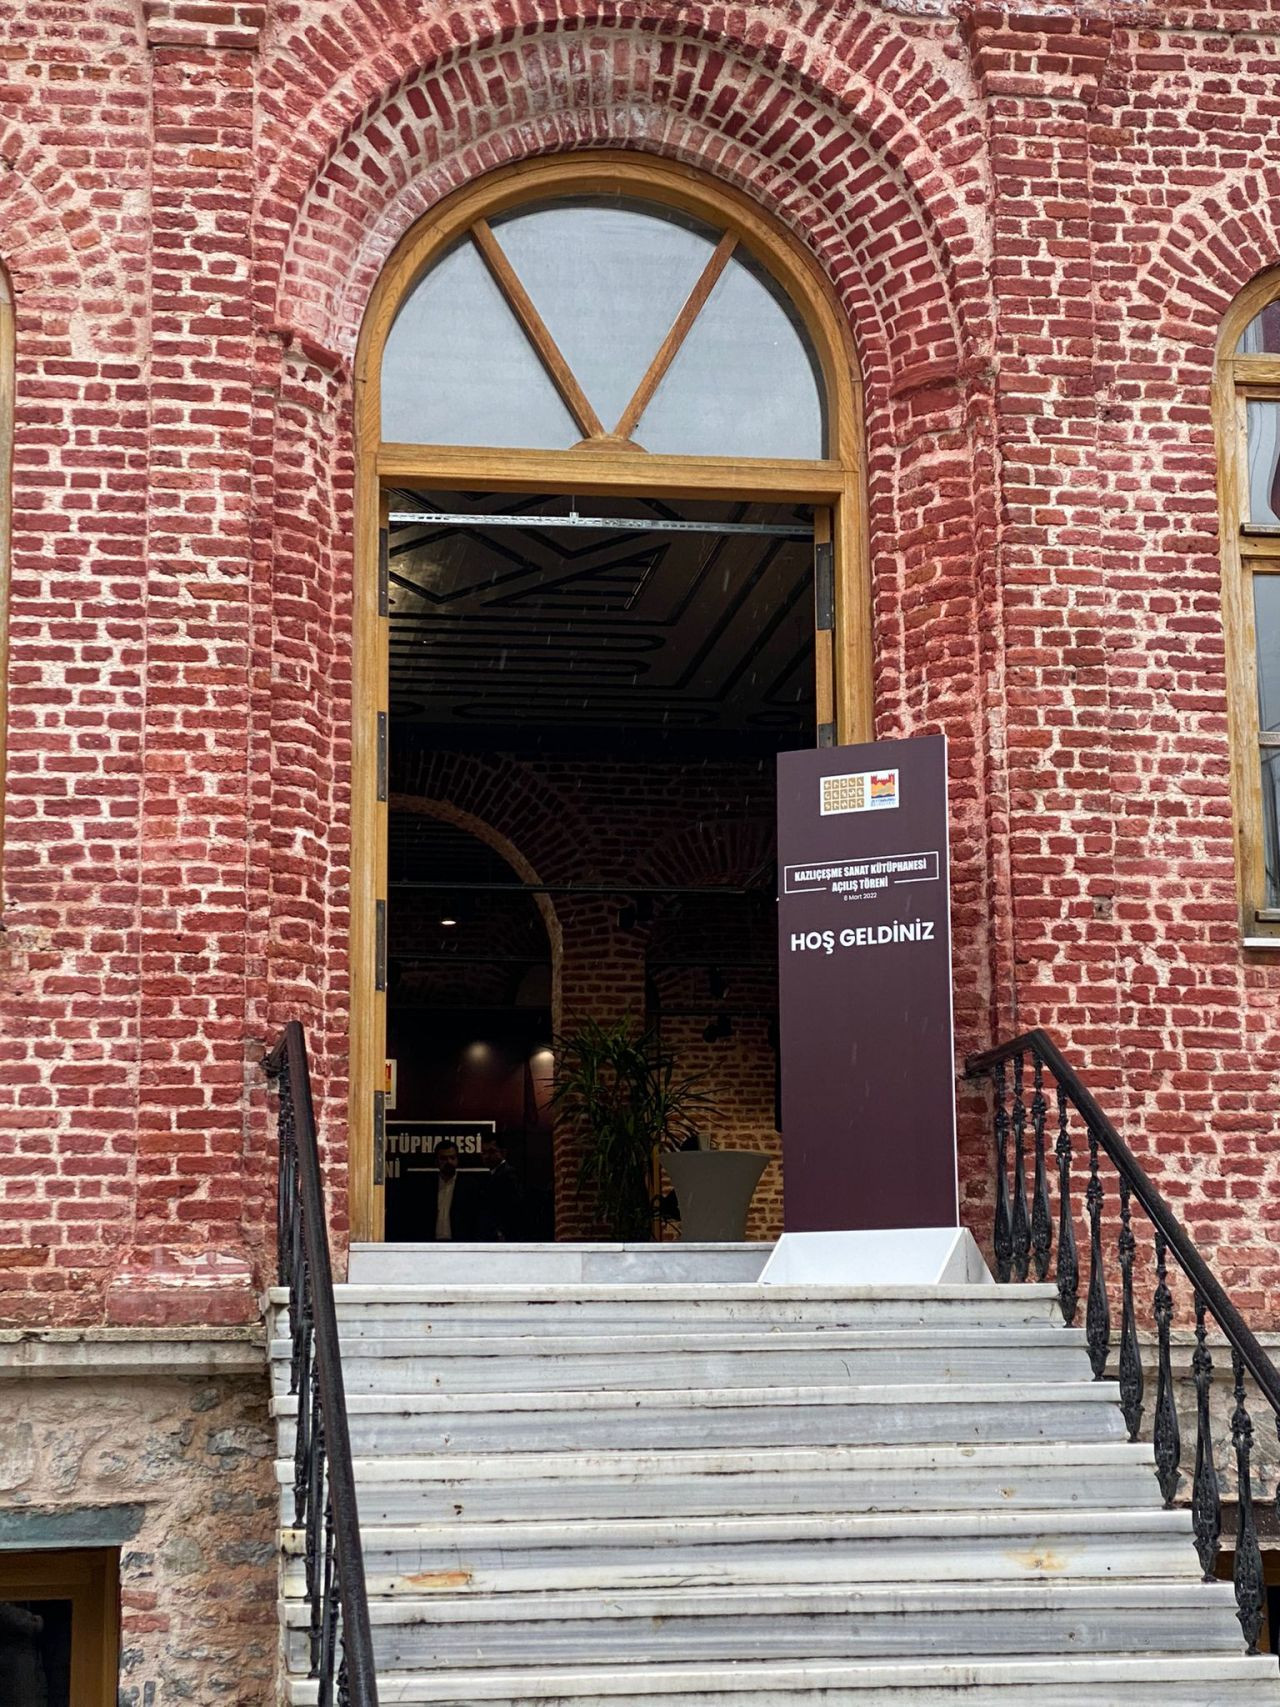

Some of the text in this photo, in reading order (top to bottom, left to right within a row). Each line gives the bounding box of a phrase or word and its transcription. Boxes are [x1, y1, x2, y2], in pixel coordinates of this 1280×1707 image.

[794, 858, 926, 881] KAZLIÇEŞME SANAT KÜTÜPHANESİ
[832, 876, 888, 893] AÇILIŞ TÖRENİ
[791, 918, 935, 954] HOŞ GELDİNİZ
